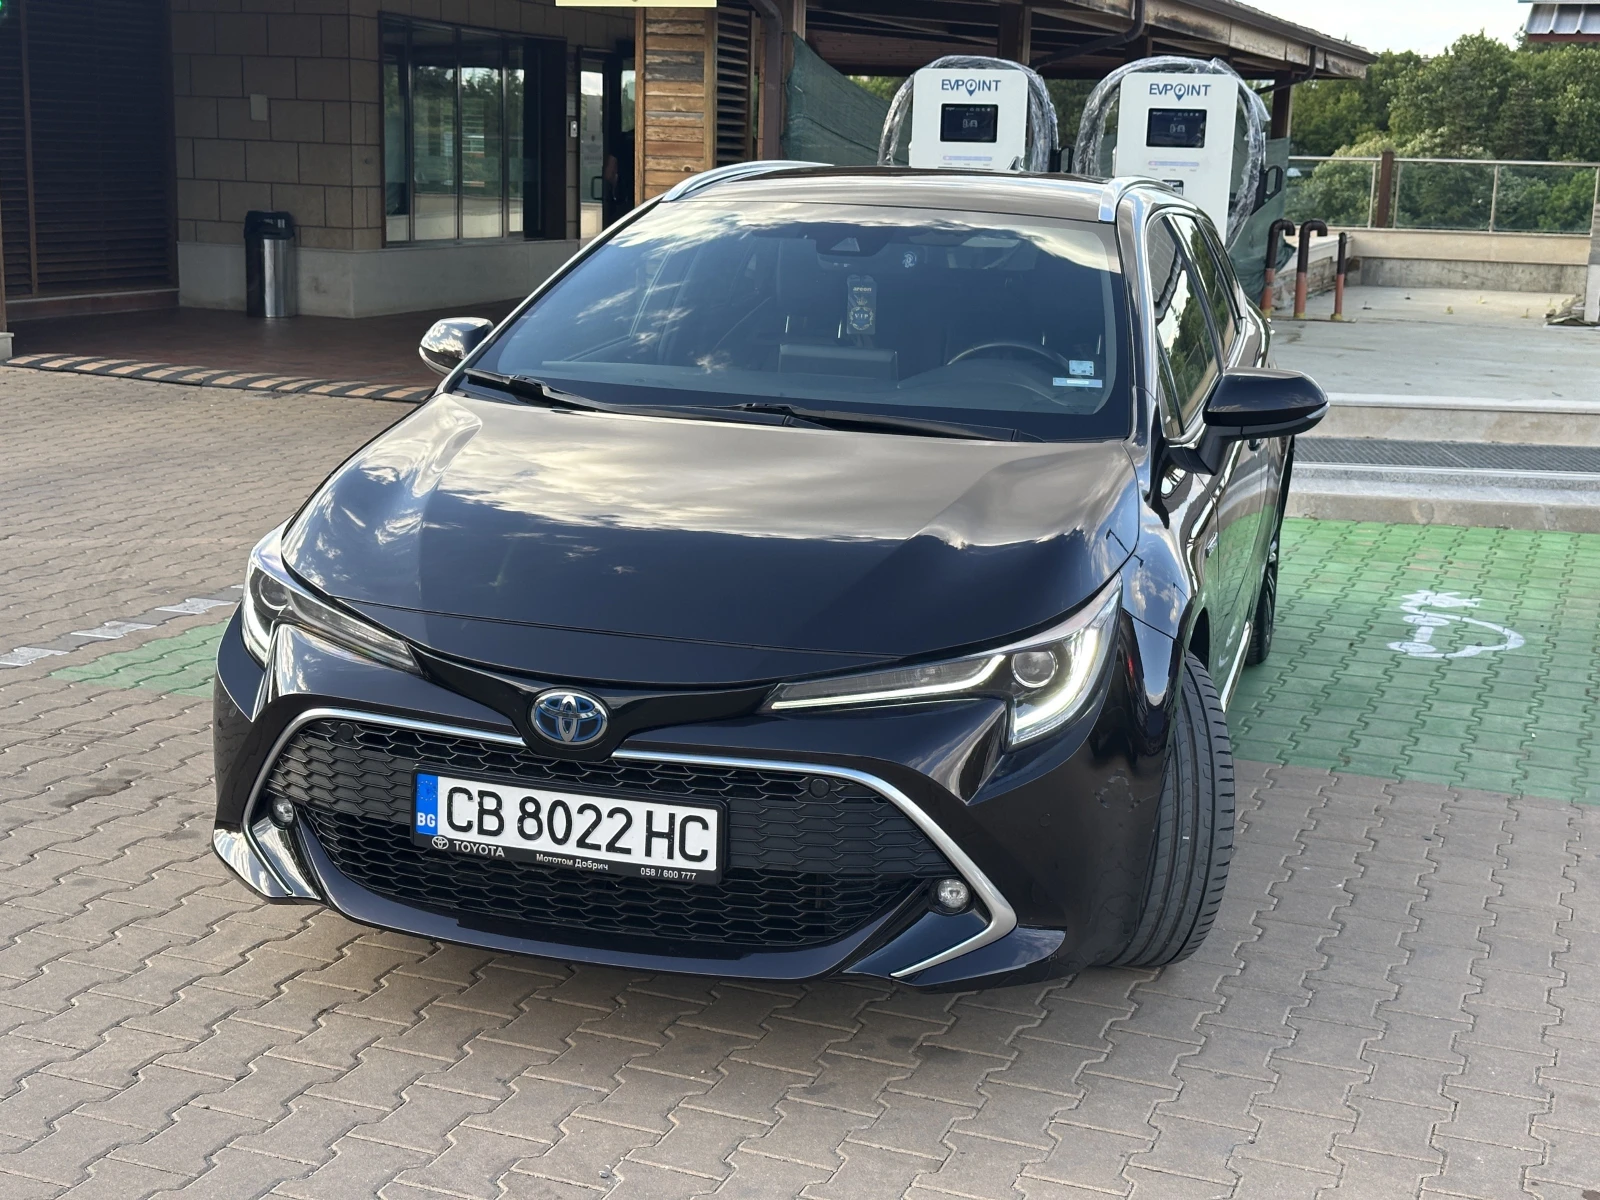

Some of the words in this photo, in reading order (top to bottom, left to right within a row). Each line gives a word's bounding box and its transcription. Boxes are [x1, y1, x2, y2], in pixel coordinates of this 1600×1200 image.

[941, 79, 1001, 97] EVPOINT
[1149, 83, 1211, 101] EVPOINT
[417, 811, 436, 828] BG
[446, 786, 505, 837] CB
[517, 796, 633, 855] 8022
[645, 810, 709, 863] HC
[453, 840, 505, 858] TOYOTA
[536, 853, 574, 866] Мототом
[574, 859, 609, 871] Добрич
[640, 867, 656, 877] 058
[663, 869, 679, 879] 600
[680, 871, 697, 880] 777
